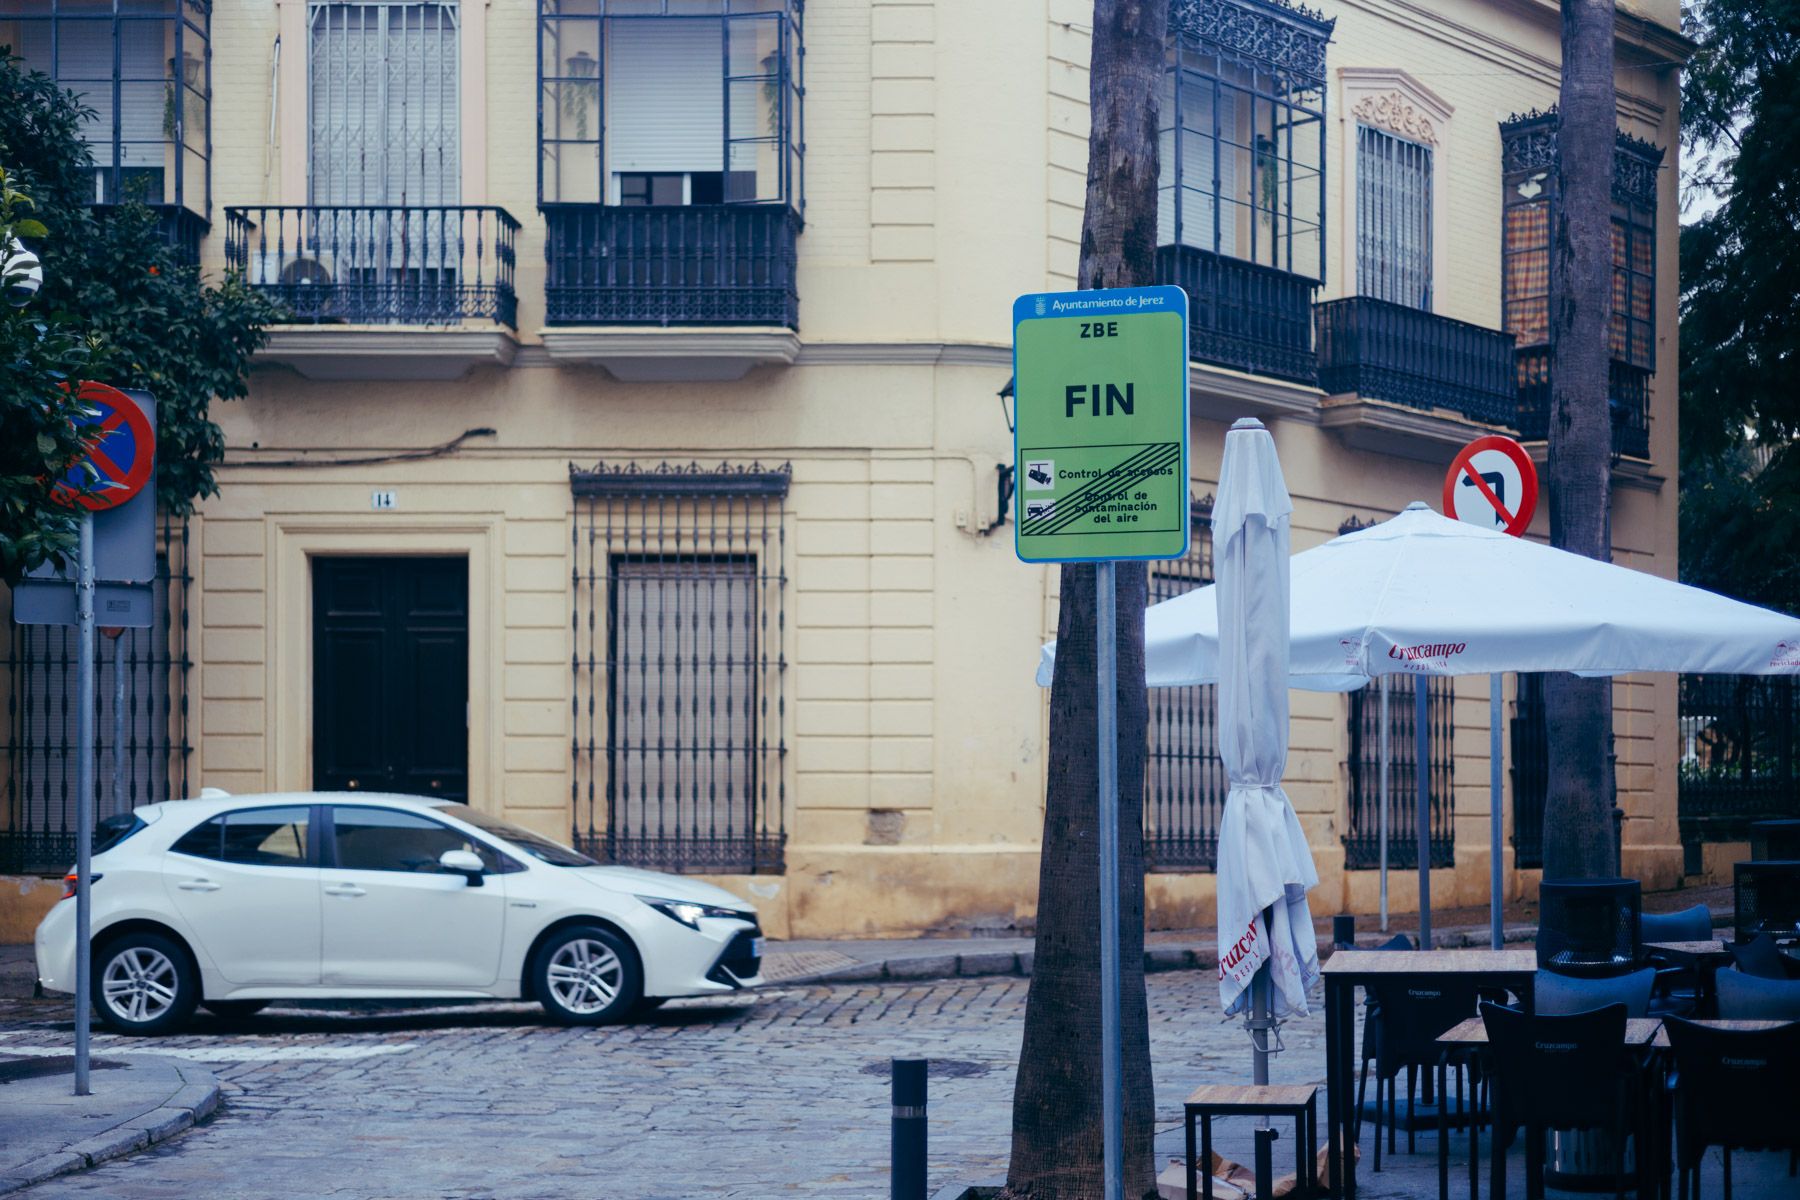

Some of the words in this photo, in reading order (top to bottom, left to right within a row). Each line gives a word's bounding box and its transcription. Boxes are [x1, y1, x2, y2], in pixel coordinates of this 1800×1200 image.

[1052, 297, 1124, 312] Ayuntamiento
[1125, 297, 1138, 306] de
[1138, 296, 1164, 308] Jerez
[1080, 322, 1119, 338] ZBE
[1065, 382, 1135, 418] FIN
[1058, 469, 1102, 480] Control
[1084, 491, 1128, 501] Control
[1134, 491, 1148, 500] de
[1075, 501, 1158, 513] contaminación
[1093, 513, 1111, 524] del
[1116, 513, 1139, 523] aire
[1388, 641, 1467, 660] Cruzcampo
